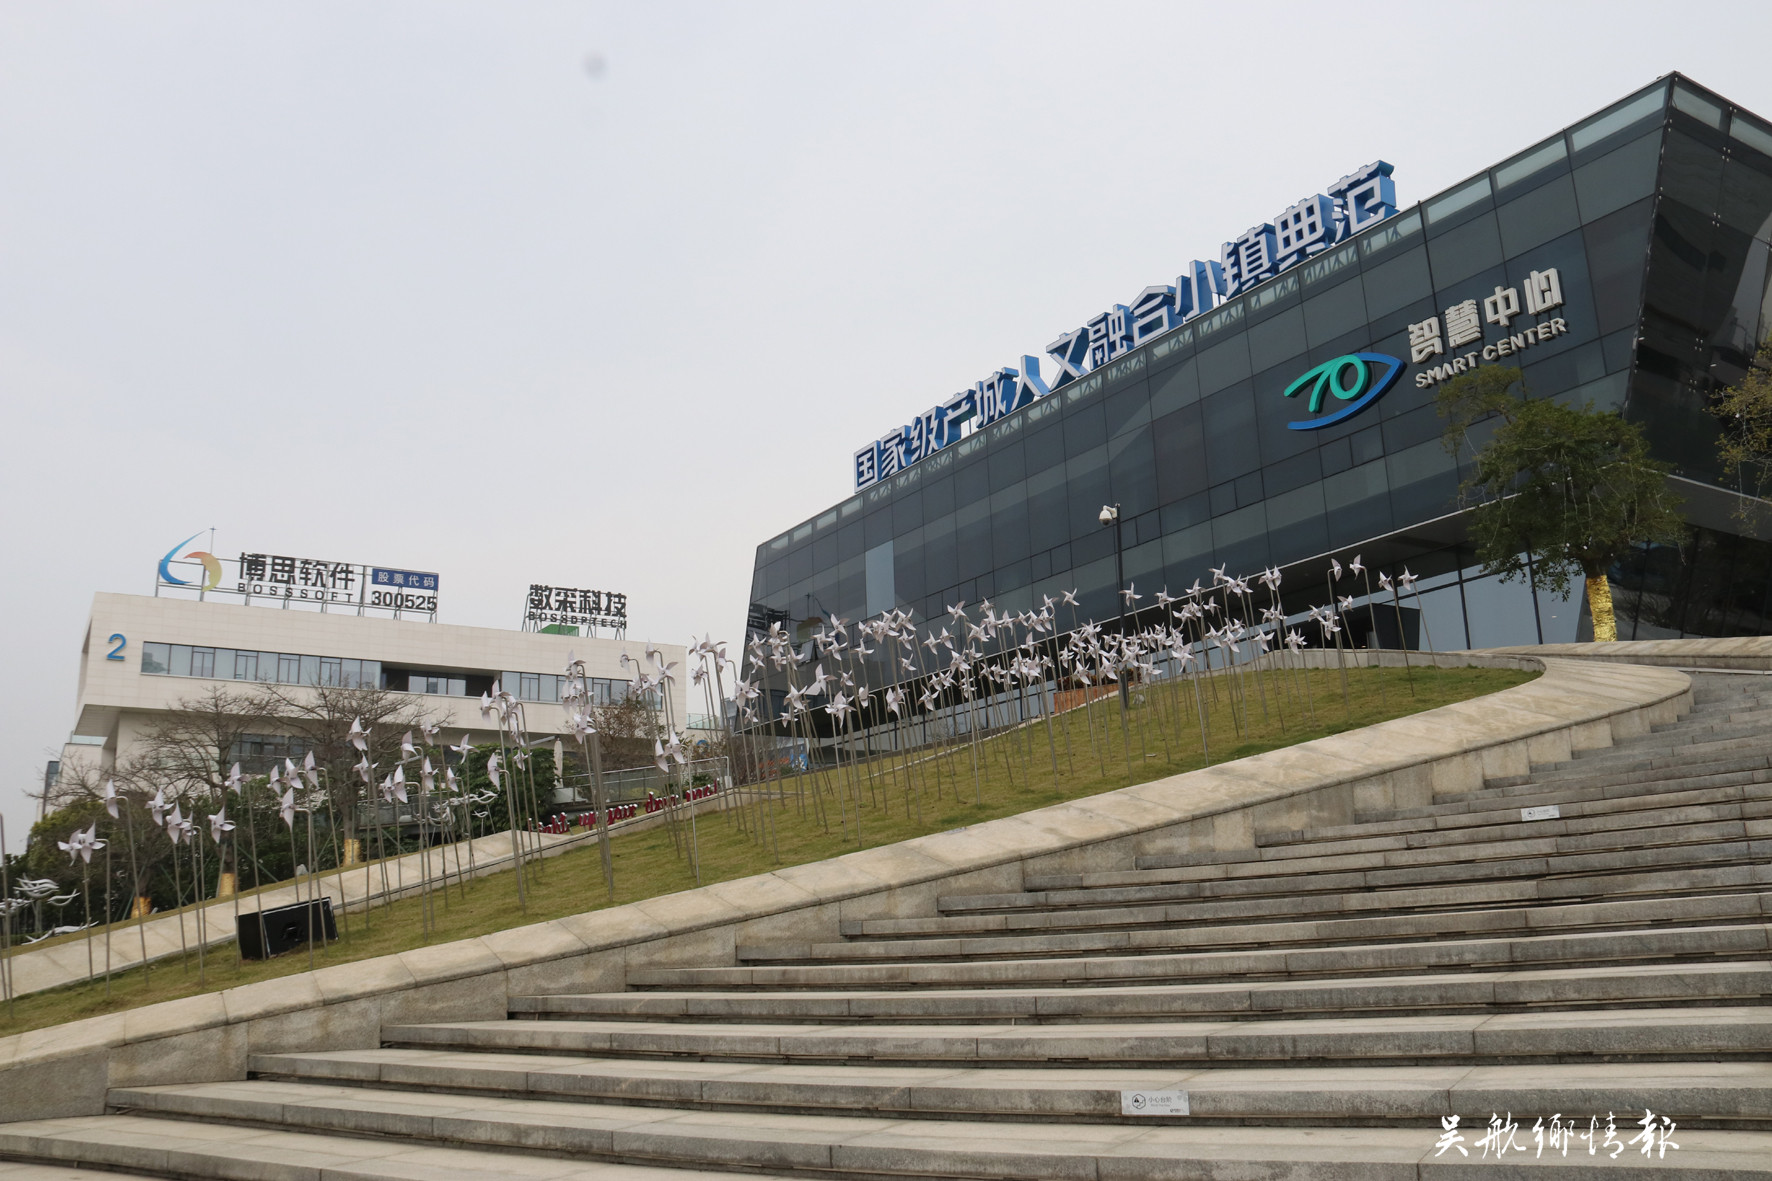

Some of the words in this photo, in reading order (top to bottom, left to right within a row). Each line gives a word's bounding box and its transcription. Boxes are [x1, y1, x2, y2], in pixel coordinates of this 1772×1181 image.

[853, 160, 1398, 493] 国家级产城人文融合小镇典范
[1407, 267, 1563, 364] 智慧中心
[1415, 351, 1478, 388] SMART
[1482, 317, 1567, 361] CENTER
[239, 552, 355, 590] 博思软件
[377, 571, 436, 588] 股票代码
[237, 582, 354, 604] BOSSSOFT
[371, 590, 438, 612] 300525
[529, 584, 627, 618] 数采科技
[106, 633, 127, 660] 2
